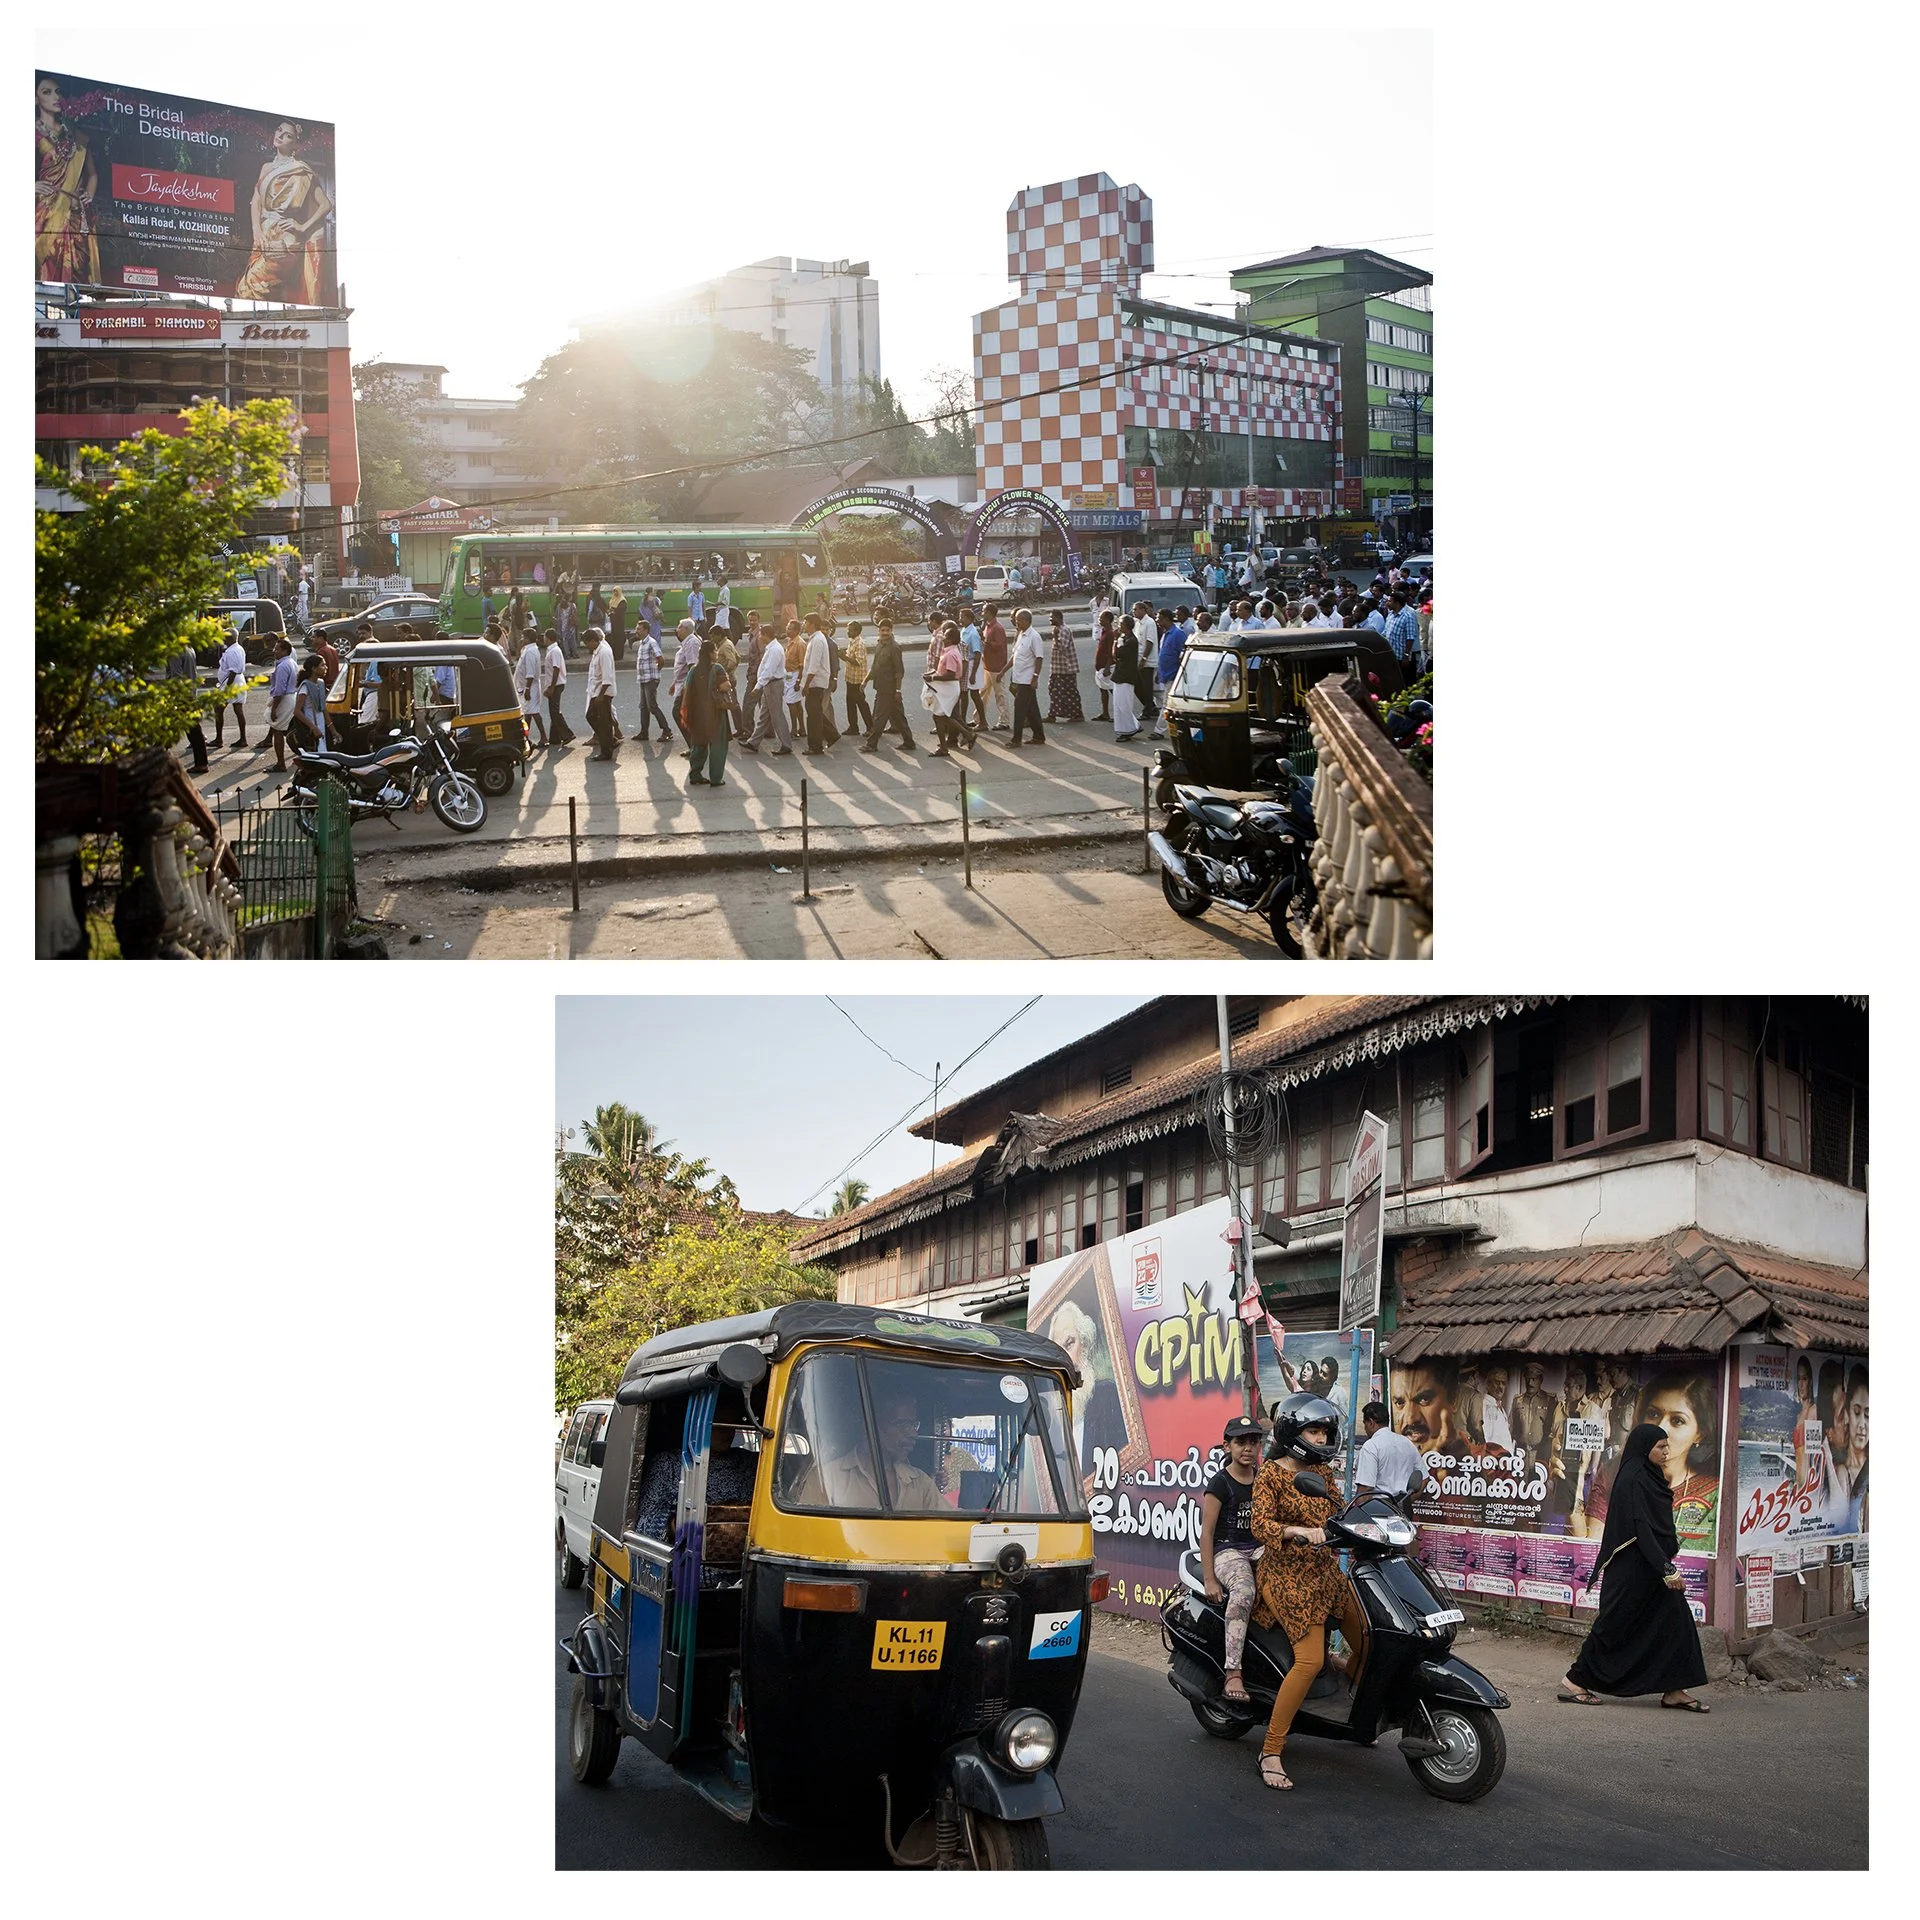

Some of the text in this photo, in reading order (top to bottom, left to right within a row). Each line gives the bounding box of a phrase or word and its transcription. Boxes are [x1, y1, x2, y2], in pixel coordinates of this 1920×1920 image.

[102, 96, 184, 123] The Bridal
[139, 120, 229, 148] Destination
[128, 172, 220, 202] Jayalakshmi
[114, 200, 235, 222] The Bridal Destination
[122, 213, 230, 236] Kallai Road, KOZHIKODE
[174, 275, 195, 283] Opening
[178, 282, 214, 291] THRISSUR
[95, 317, 205, 329] PARAMBIL DIAMOND
[239, 324, 310, 341] Bata
[806, 499, 826, 514] KERALA
[827, 489, 850, 502] PRIMARY
[856, 487, 887, 495] SECONDARY
[889, 488, 914, 503] TEACHERS
[915, 500, 931, 513] UNION
[975, 490, 1070, 528] CALICUT FLOWER SHOW 2012
[1092, 514, 1140, 526] METALS
[1747, 1366, 1760, 1377] WITH
[1760, 1366, 1769, 1378] THE
[1443, 1511, 1471, 1519] PICTURES
[1050, 1620, 1069, 1631] CC
[889, 1627, 933, 1644] KL.11
[1042, 1636, 1073, 1648] 2660
[877, 1647, 938, 1664] U.1166
